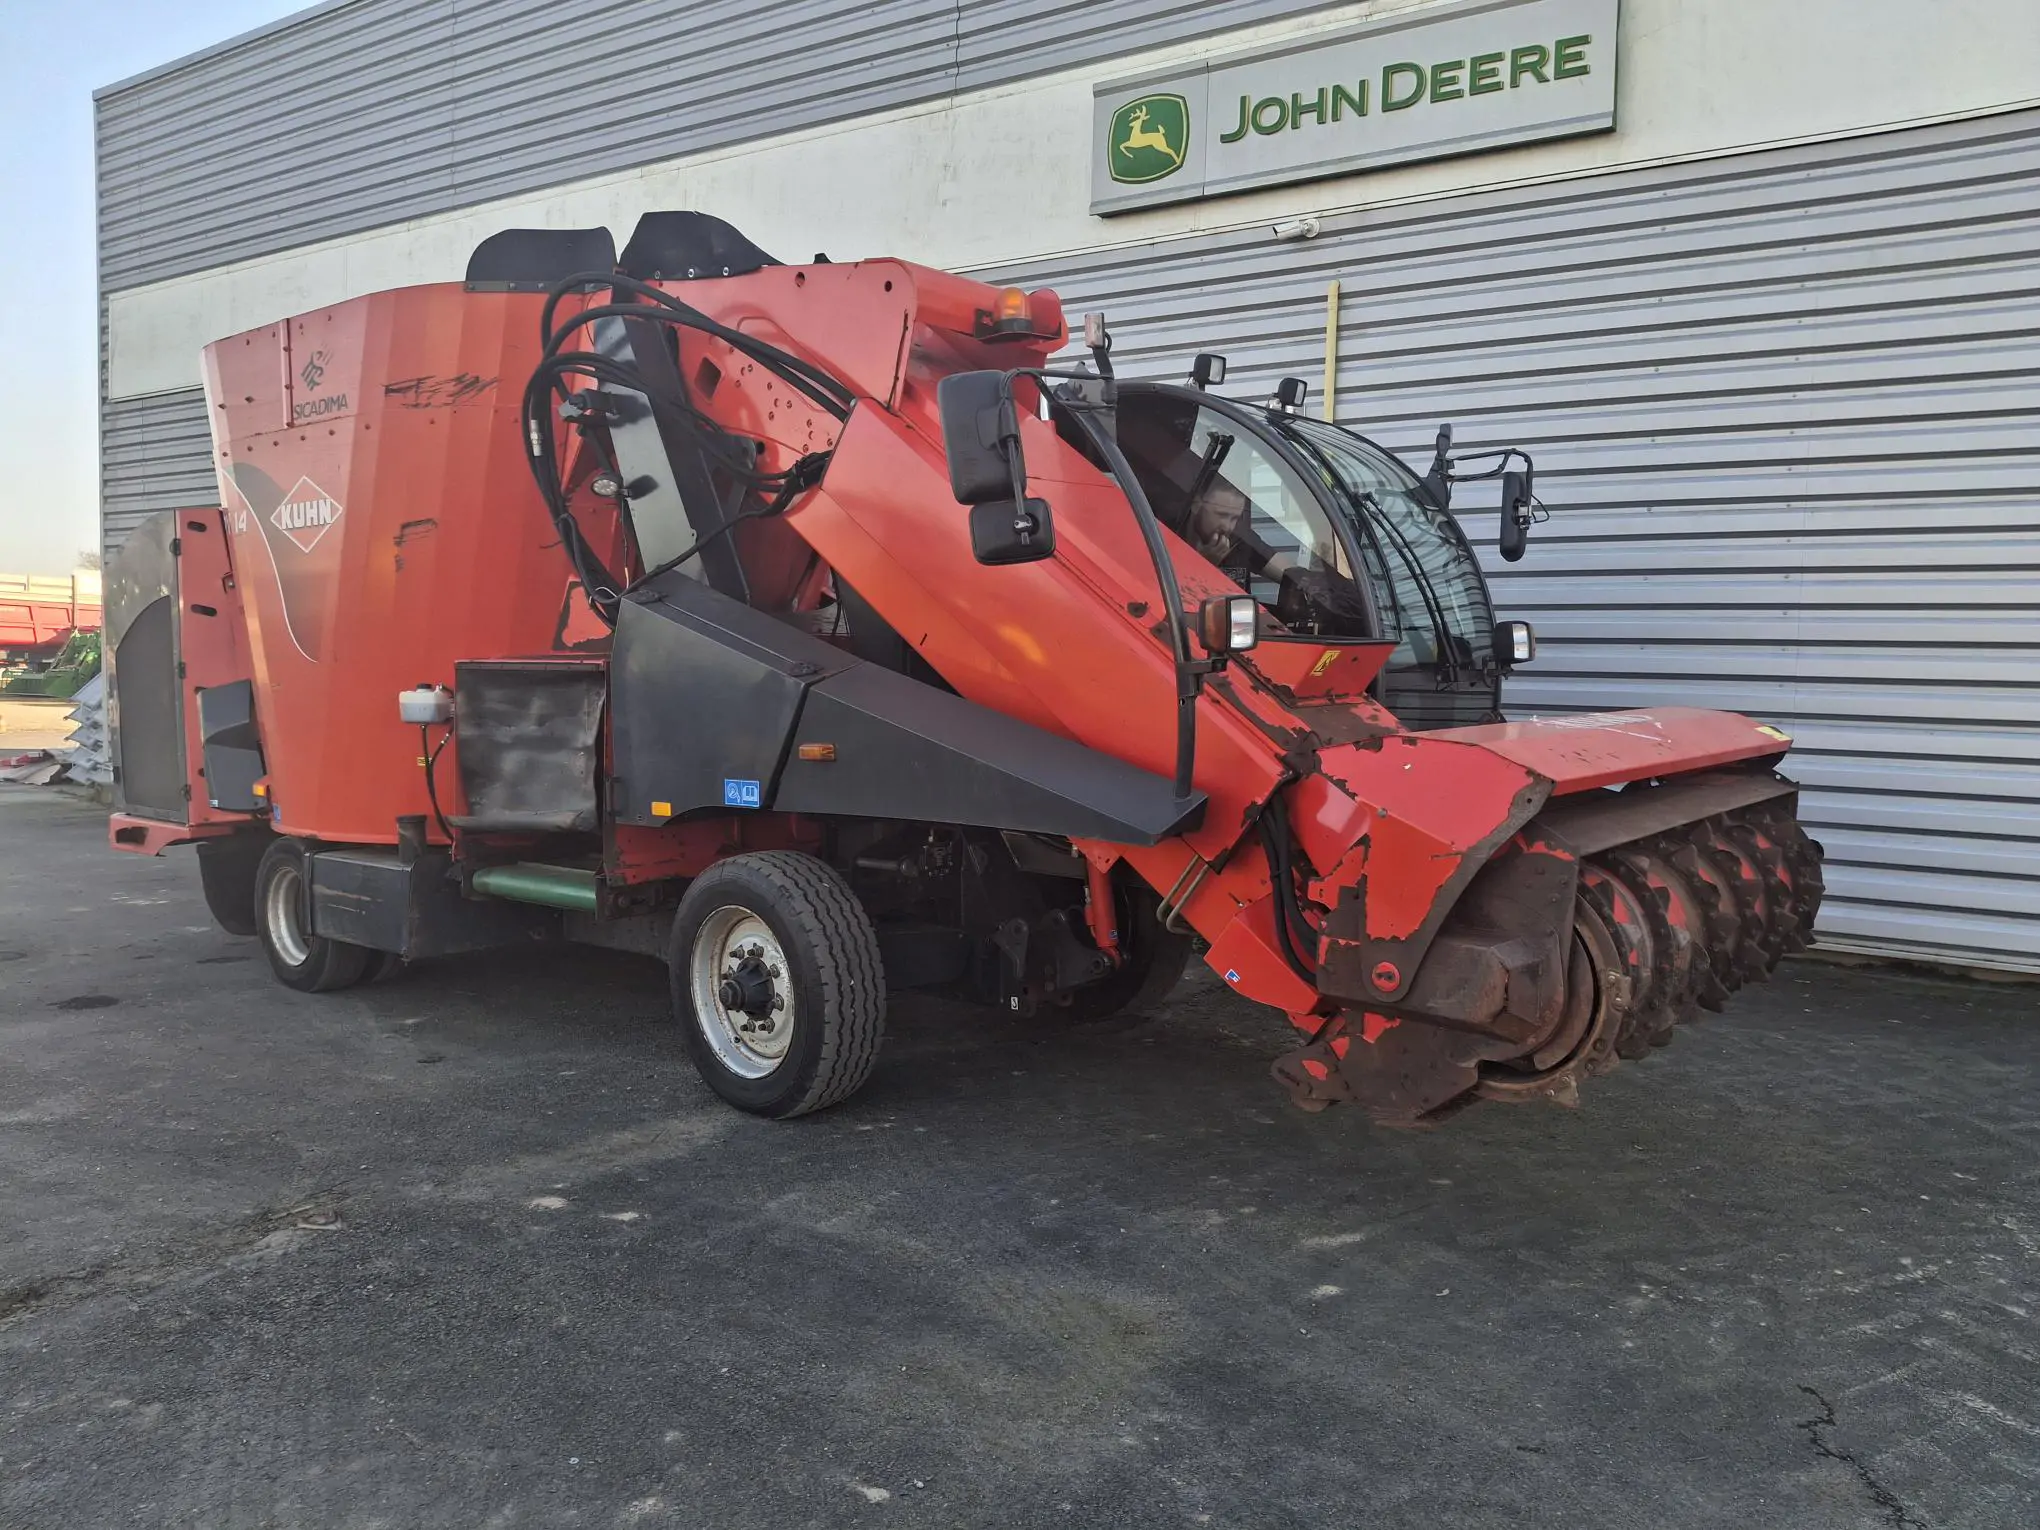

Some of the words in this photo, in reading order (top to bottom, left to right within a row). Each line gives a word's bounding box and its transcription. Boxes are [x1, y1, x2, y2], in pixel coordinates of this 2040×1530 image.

[1219, 78, 1369, 144] JOHN
[1381, 34, 1592, 113] DEERE
[294, 393, 348, 420] SICADIMA
[281, 498, 333, 530] KUHN
